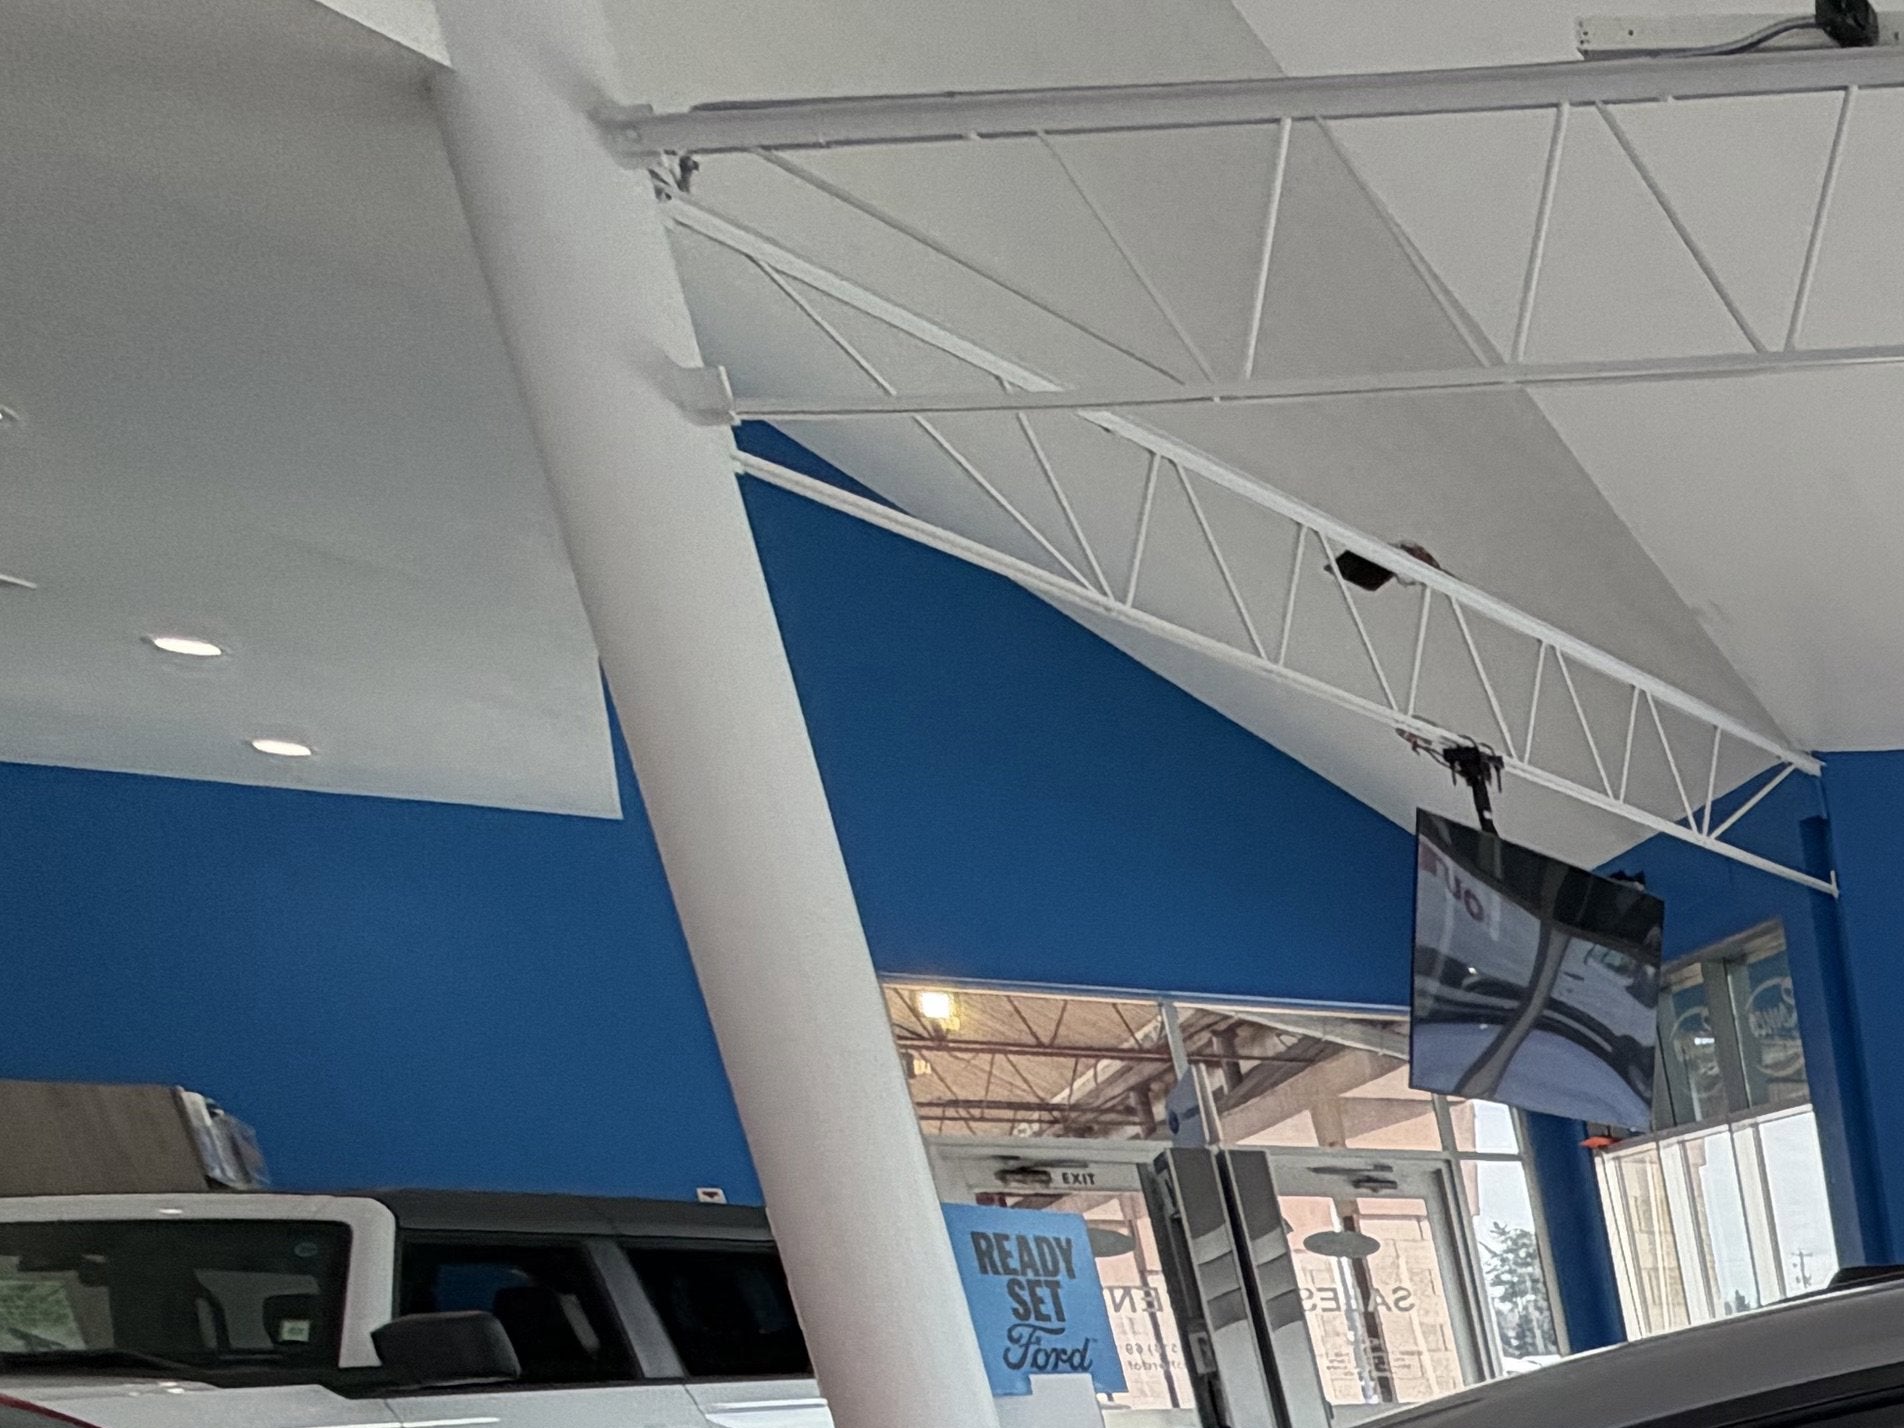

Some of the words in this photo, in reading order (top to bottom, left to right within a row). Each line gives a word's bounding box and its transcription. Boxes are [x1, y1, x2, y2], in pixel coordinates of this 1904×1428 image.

[1062, 1171, 1095, 1186] EXIT
[970, 1231, 1076, 1280] READY
[1006, 1278, 1067, 1322] SET
[1003, 1323, 1093, 1371] Ford
